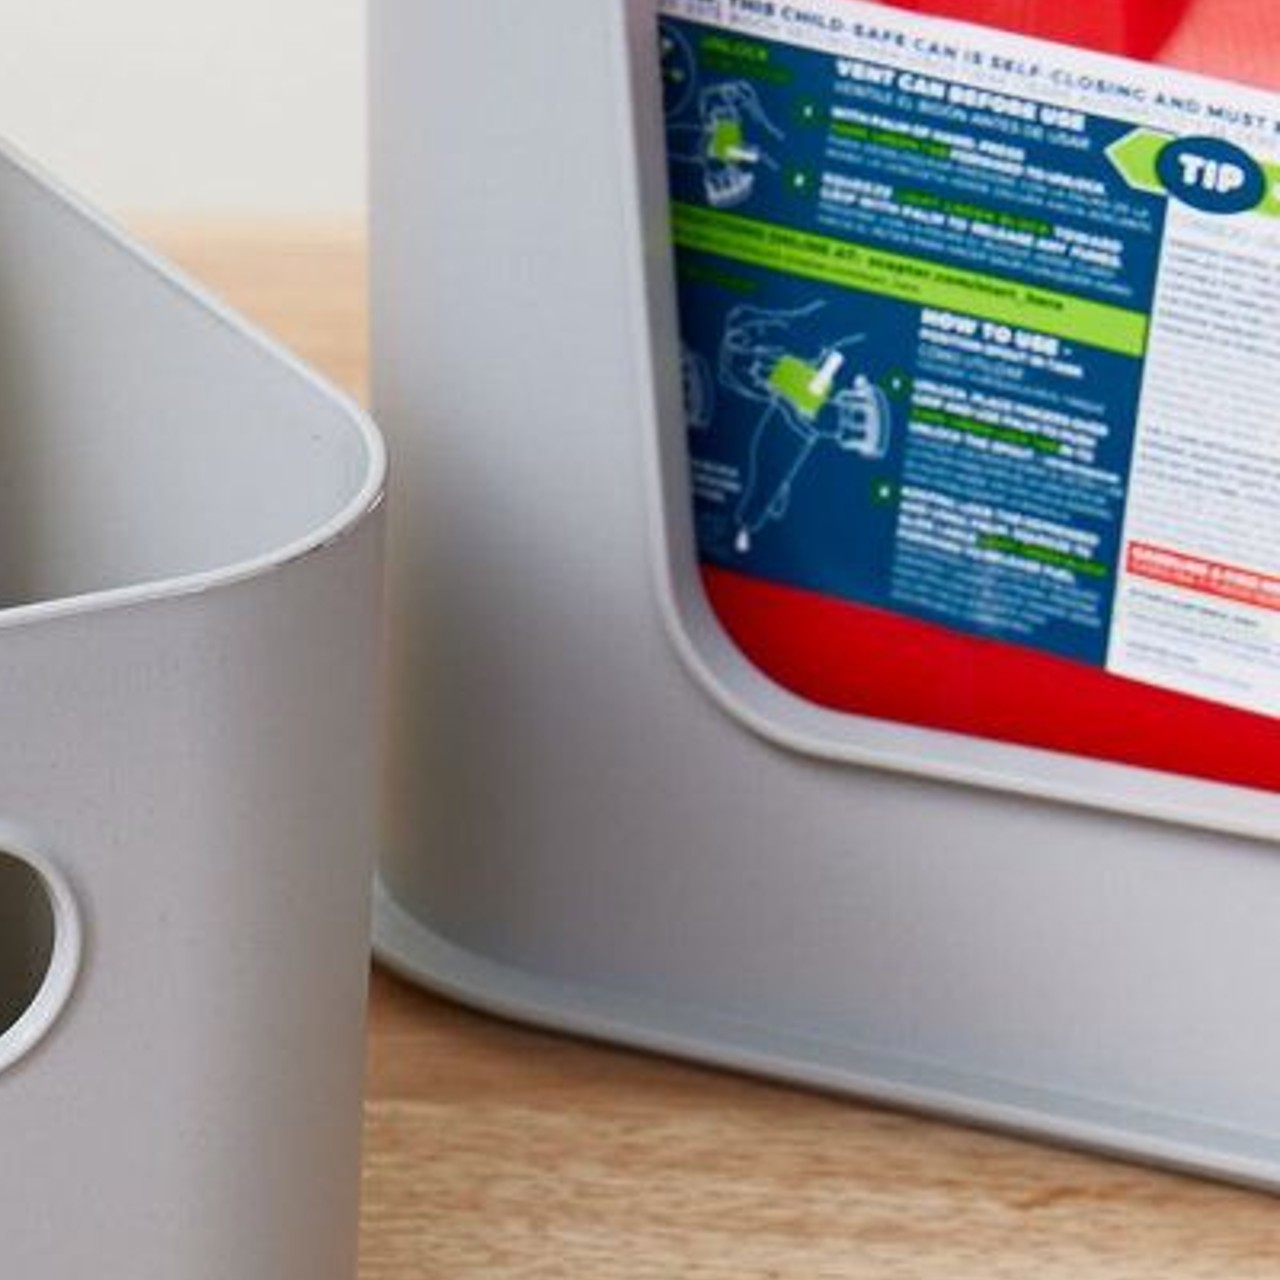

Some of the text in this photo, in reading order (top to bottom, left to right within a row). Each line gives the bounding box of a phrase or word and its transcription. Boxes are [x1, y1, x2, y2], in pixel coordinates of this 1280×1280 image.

[835, 59, 1086, 133] VENT CAN BEFORE USE
[913, 36, 958, 62] CAN
[963, 45, 983, 67] IS
[1153, 91, 1201, 117] AND
[1206, 104, 1268, 131] MUST
[1178, 153, 1246, 193] TIP
[921, 309, 1059, 356] HOW TO USE
